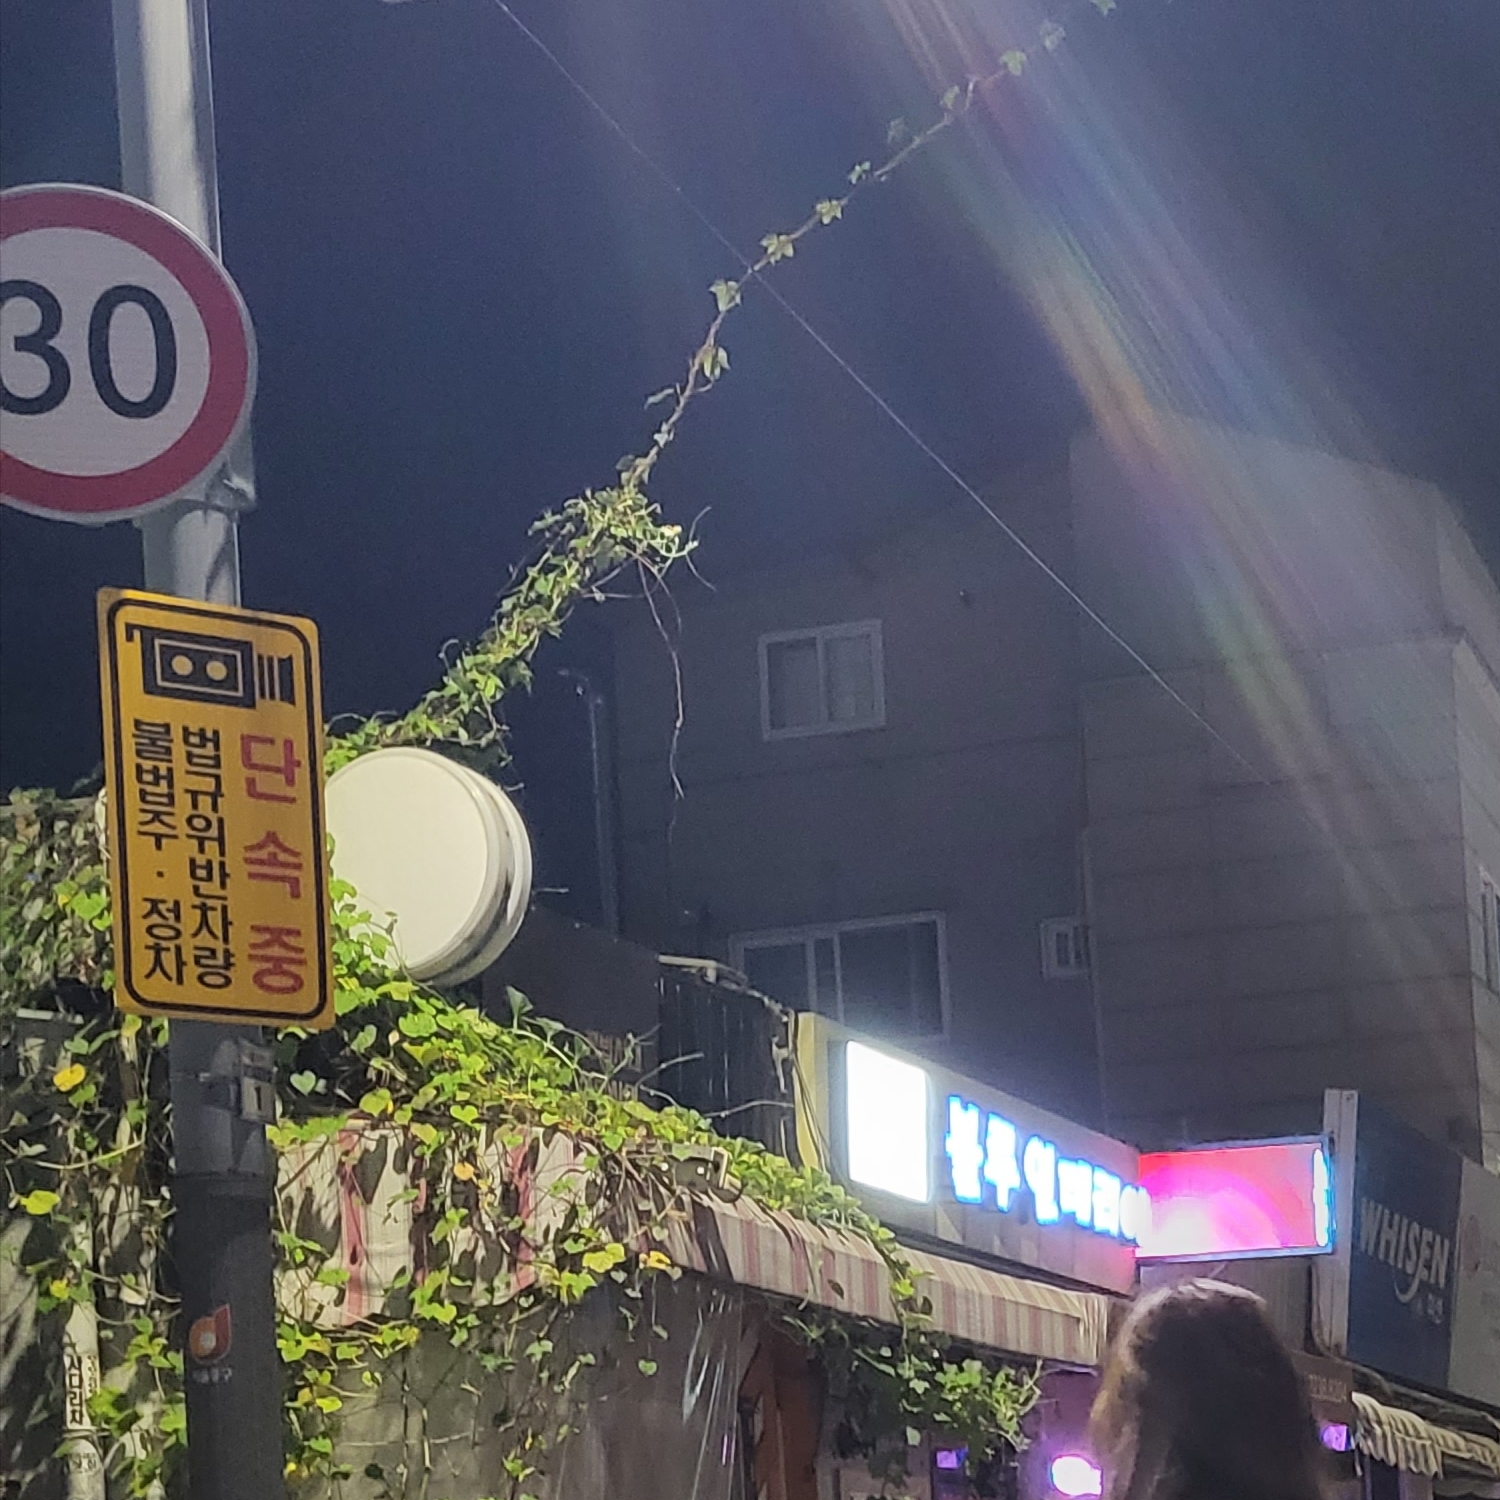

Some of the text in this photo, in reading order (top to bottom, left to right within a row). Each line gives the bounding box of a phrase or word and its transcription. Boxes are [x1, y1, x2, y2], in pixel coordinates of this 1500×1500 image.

[0, 278, 178, 420] 30
[181, 724, 235, 990] 법규위반차량
[1360, 1196, 1450, 1302] WHISEN
